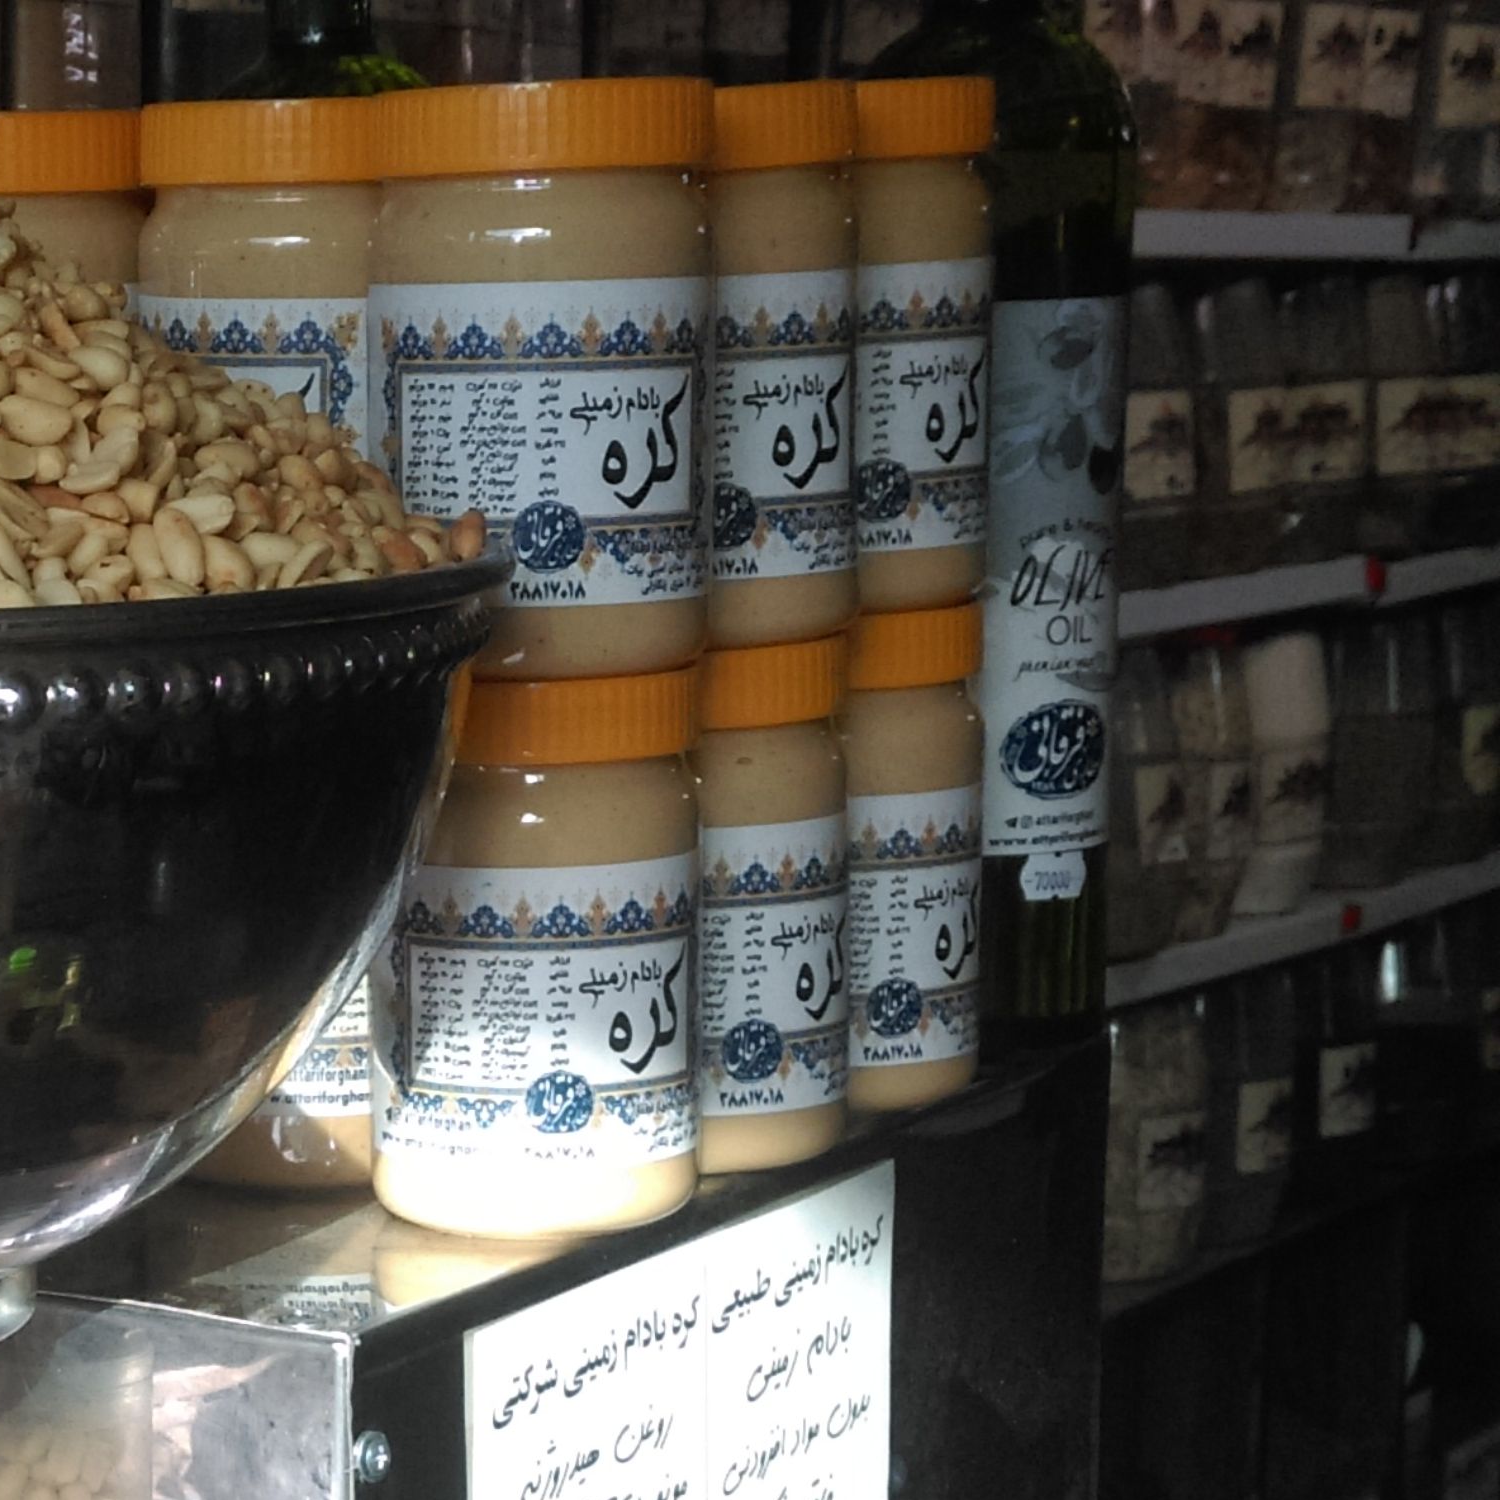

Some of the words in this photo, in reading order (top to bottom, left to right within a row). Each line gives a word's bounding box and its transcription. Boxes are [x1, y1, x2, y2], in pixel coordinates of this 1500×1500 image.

[600, 373, 690, 509] کره
[772, 357, 848, 489] کره
[1046, 615, 1093, 646] OIL
[608, 941, 686, 1074] کره
[824, 1227, 859, 1284] بادام
[862, 1215, 884, 1265] کره
[711, 1268, 772, 1334] طبیعی
[774, 1243, 822, 1307] زمینی
[624, 1308, 666, 1370] بادام
[672, 1295, 701, 1351] کره
[806, 1316, 852, 1375] بادام
[492, 1358, 559, 1430] شرکتی
[563, 1329, 619, 1398] زمینی
[746, 1328, 799, 1402] زمینی
[613, 1404, 674, 1463] روغن
